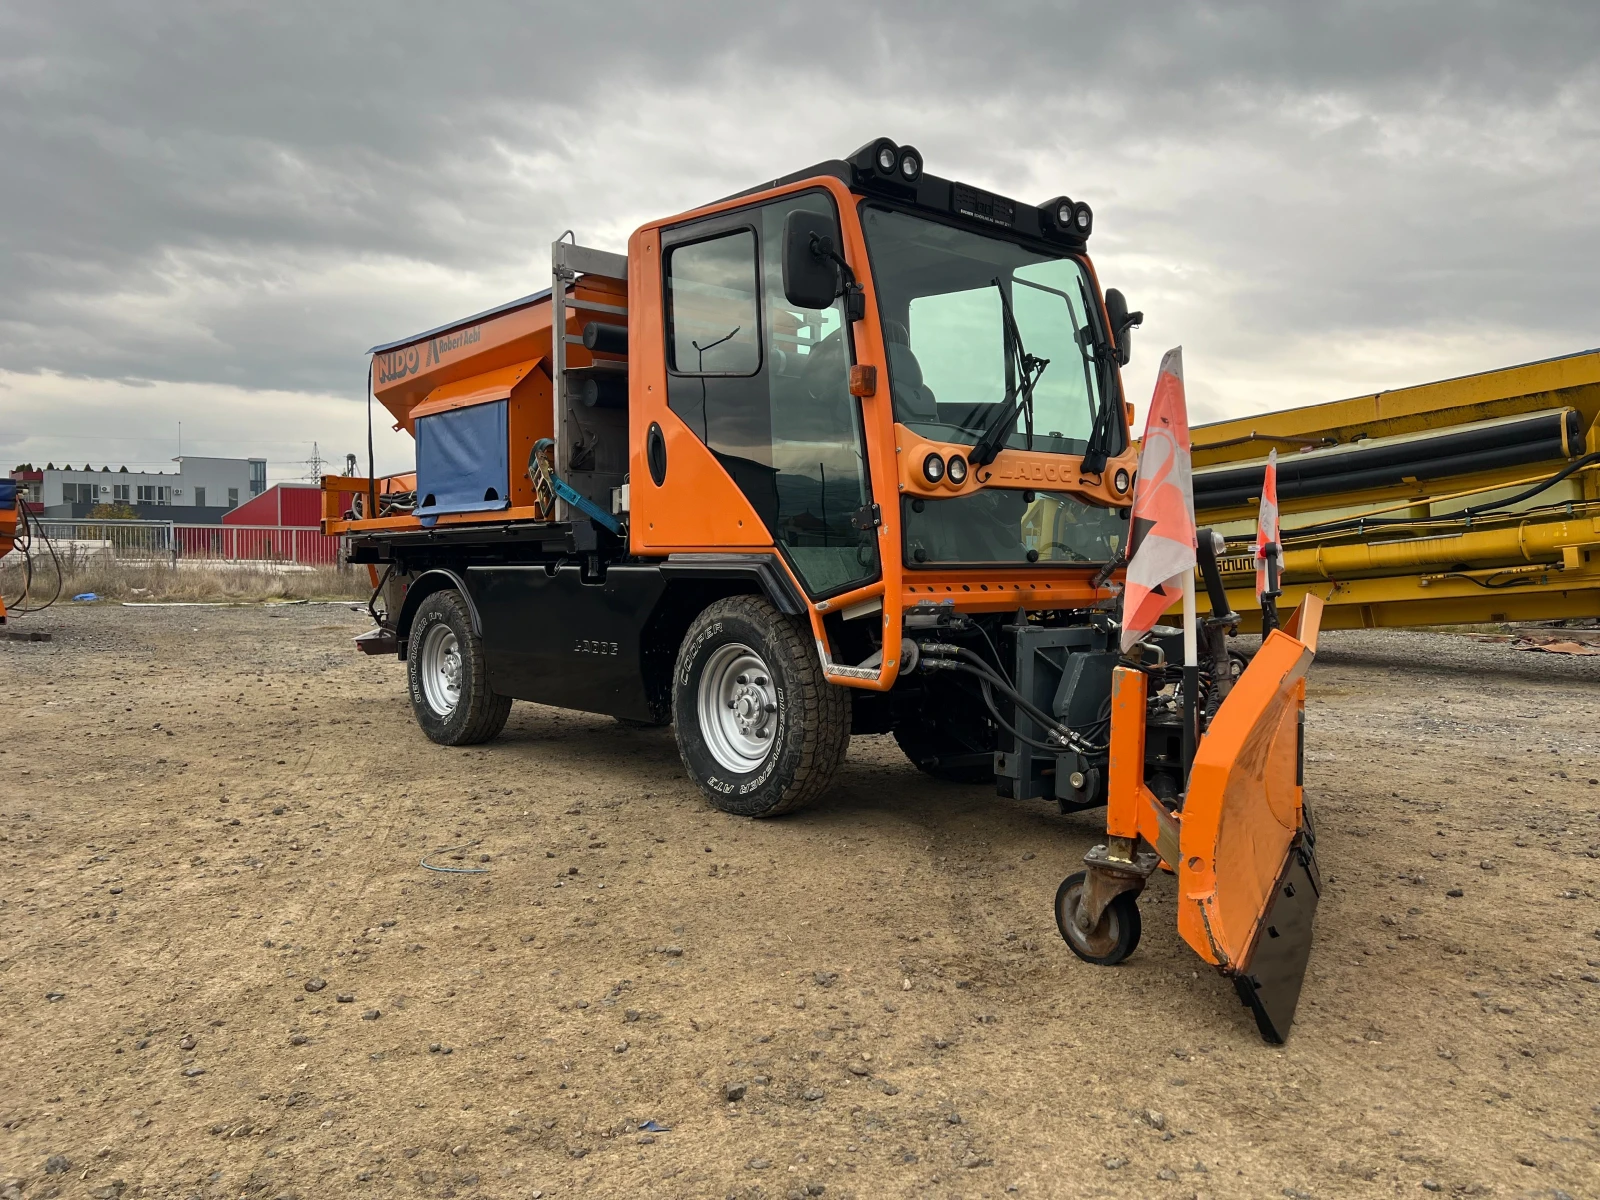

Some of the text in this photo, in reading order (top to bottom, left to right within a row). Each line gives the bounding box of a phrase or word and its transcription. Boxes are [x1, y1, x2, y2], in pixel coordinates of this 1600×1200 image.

[439, 325, 481, 354] Robert Aebi
[379, 346, 420, 384] NIDO
[1000, 459, 1073, 483] LADOG
[680, 622, 723, 686] COOPER
[707, 687, 786, 795] DISCOVERER AT3
